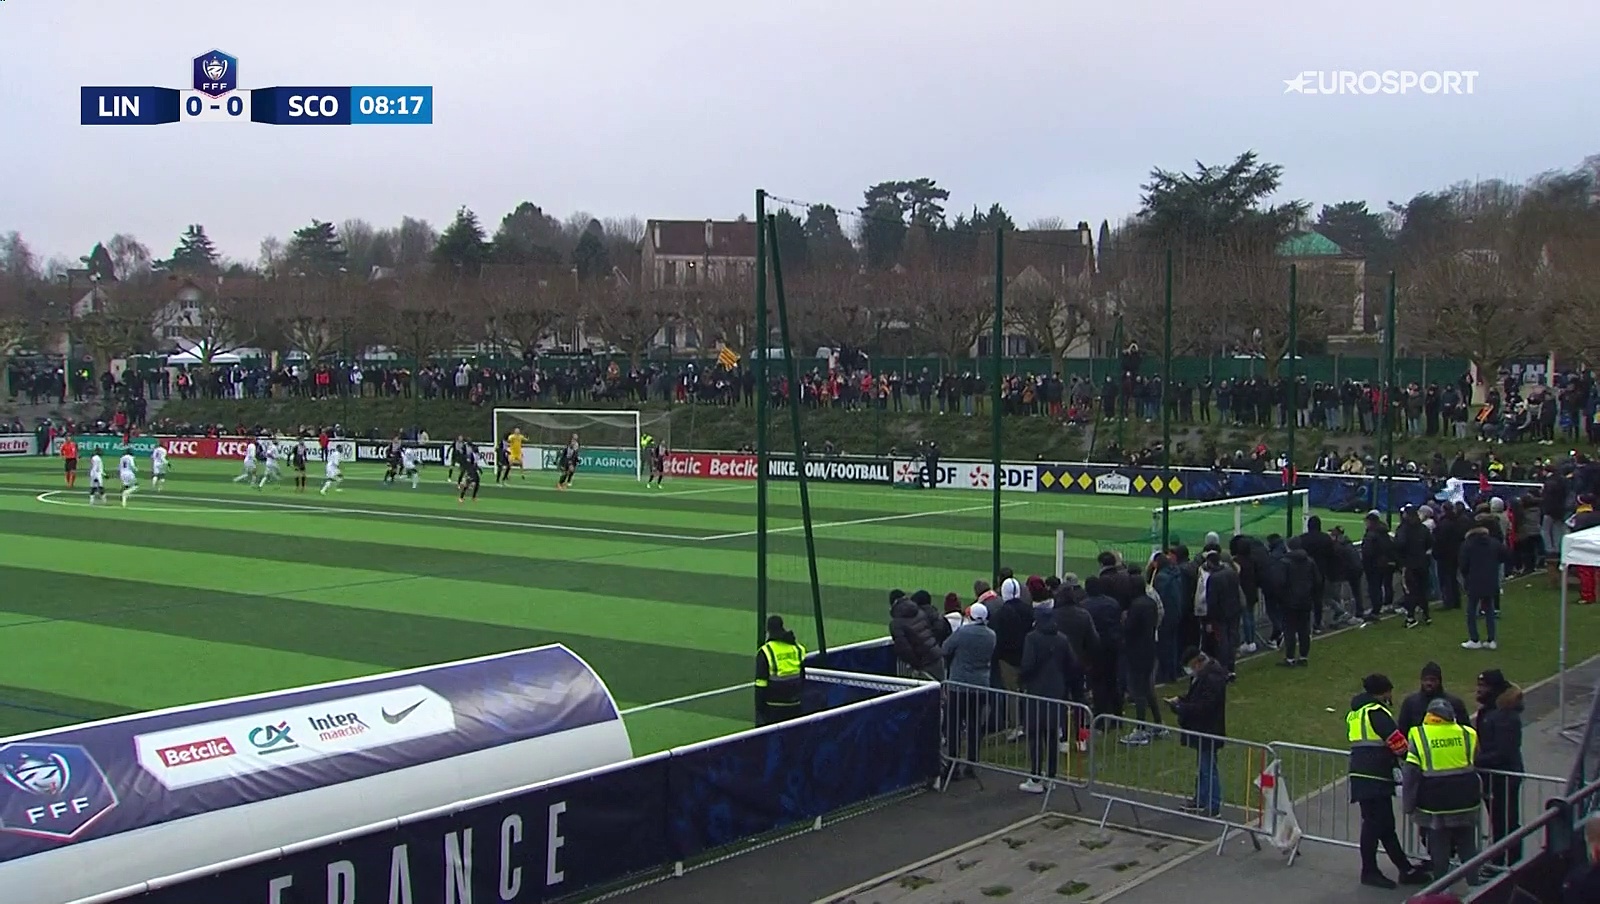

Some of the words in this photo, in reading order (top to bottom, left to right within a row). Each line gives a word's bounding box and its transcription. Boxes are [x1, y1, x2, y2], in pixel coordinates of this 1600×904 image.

[168, 440, 198, 455] KFC
[216, 441, 247, 456] KFC
[663, 457, 702, 474] etclic
[709, 458, 758, 477] Betclic
[768, 460, 890, 481] NIKE.OM/FOOTBALL
[165, 740, 230, 766] Betclic
[26, 797, 90, 824] FFF
